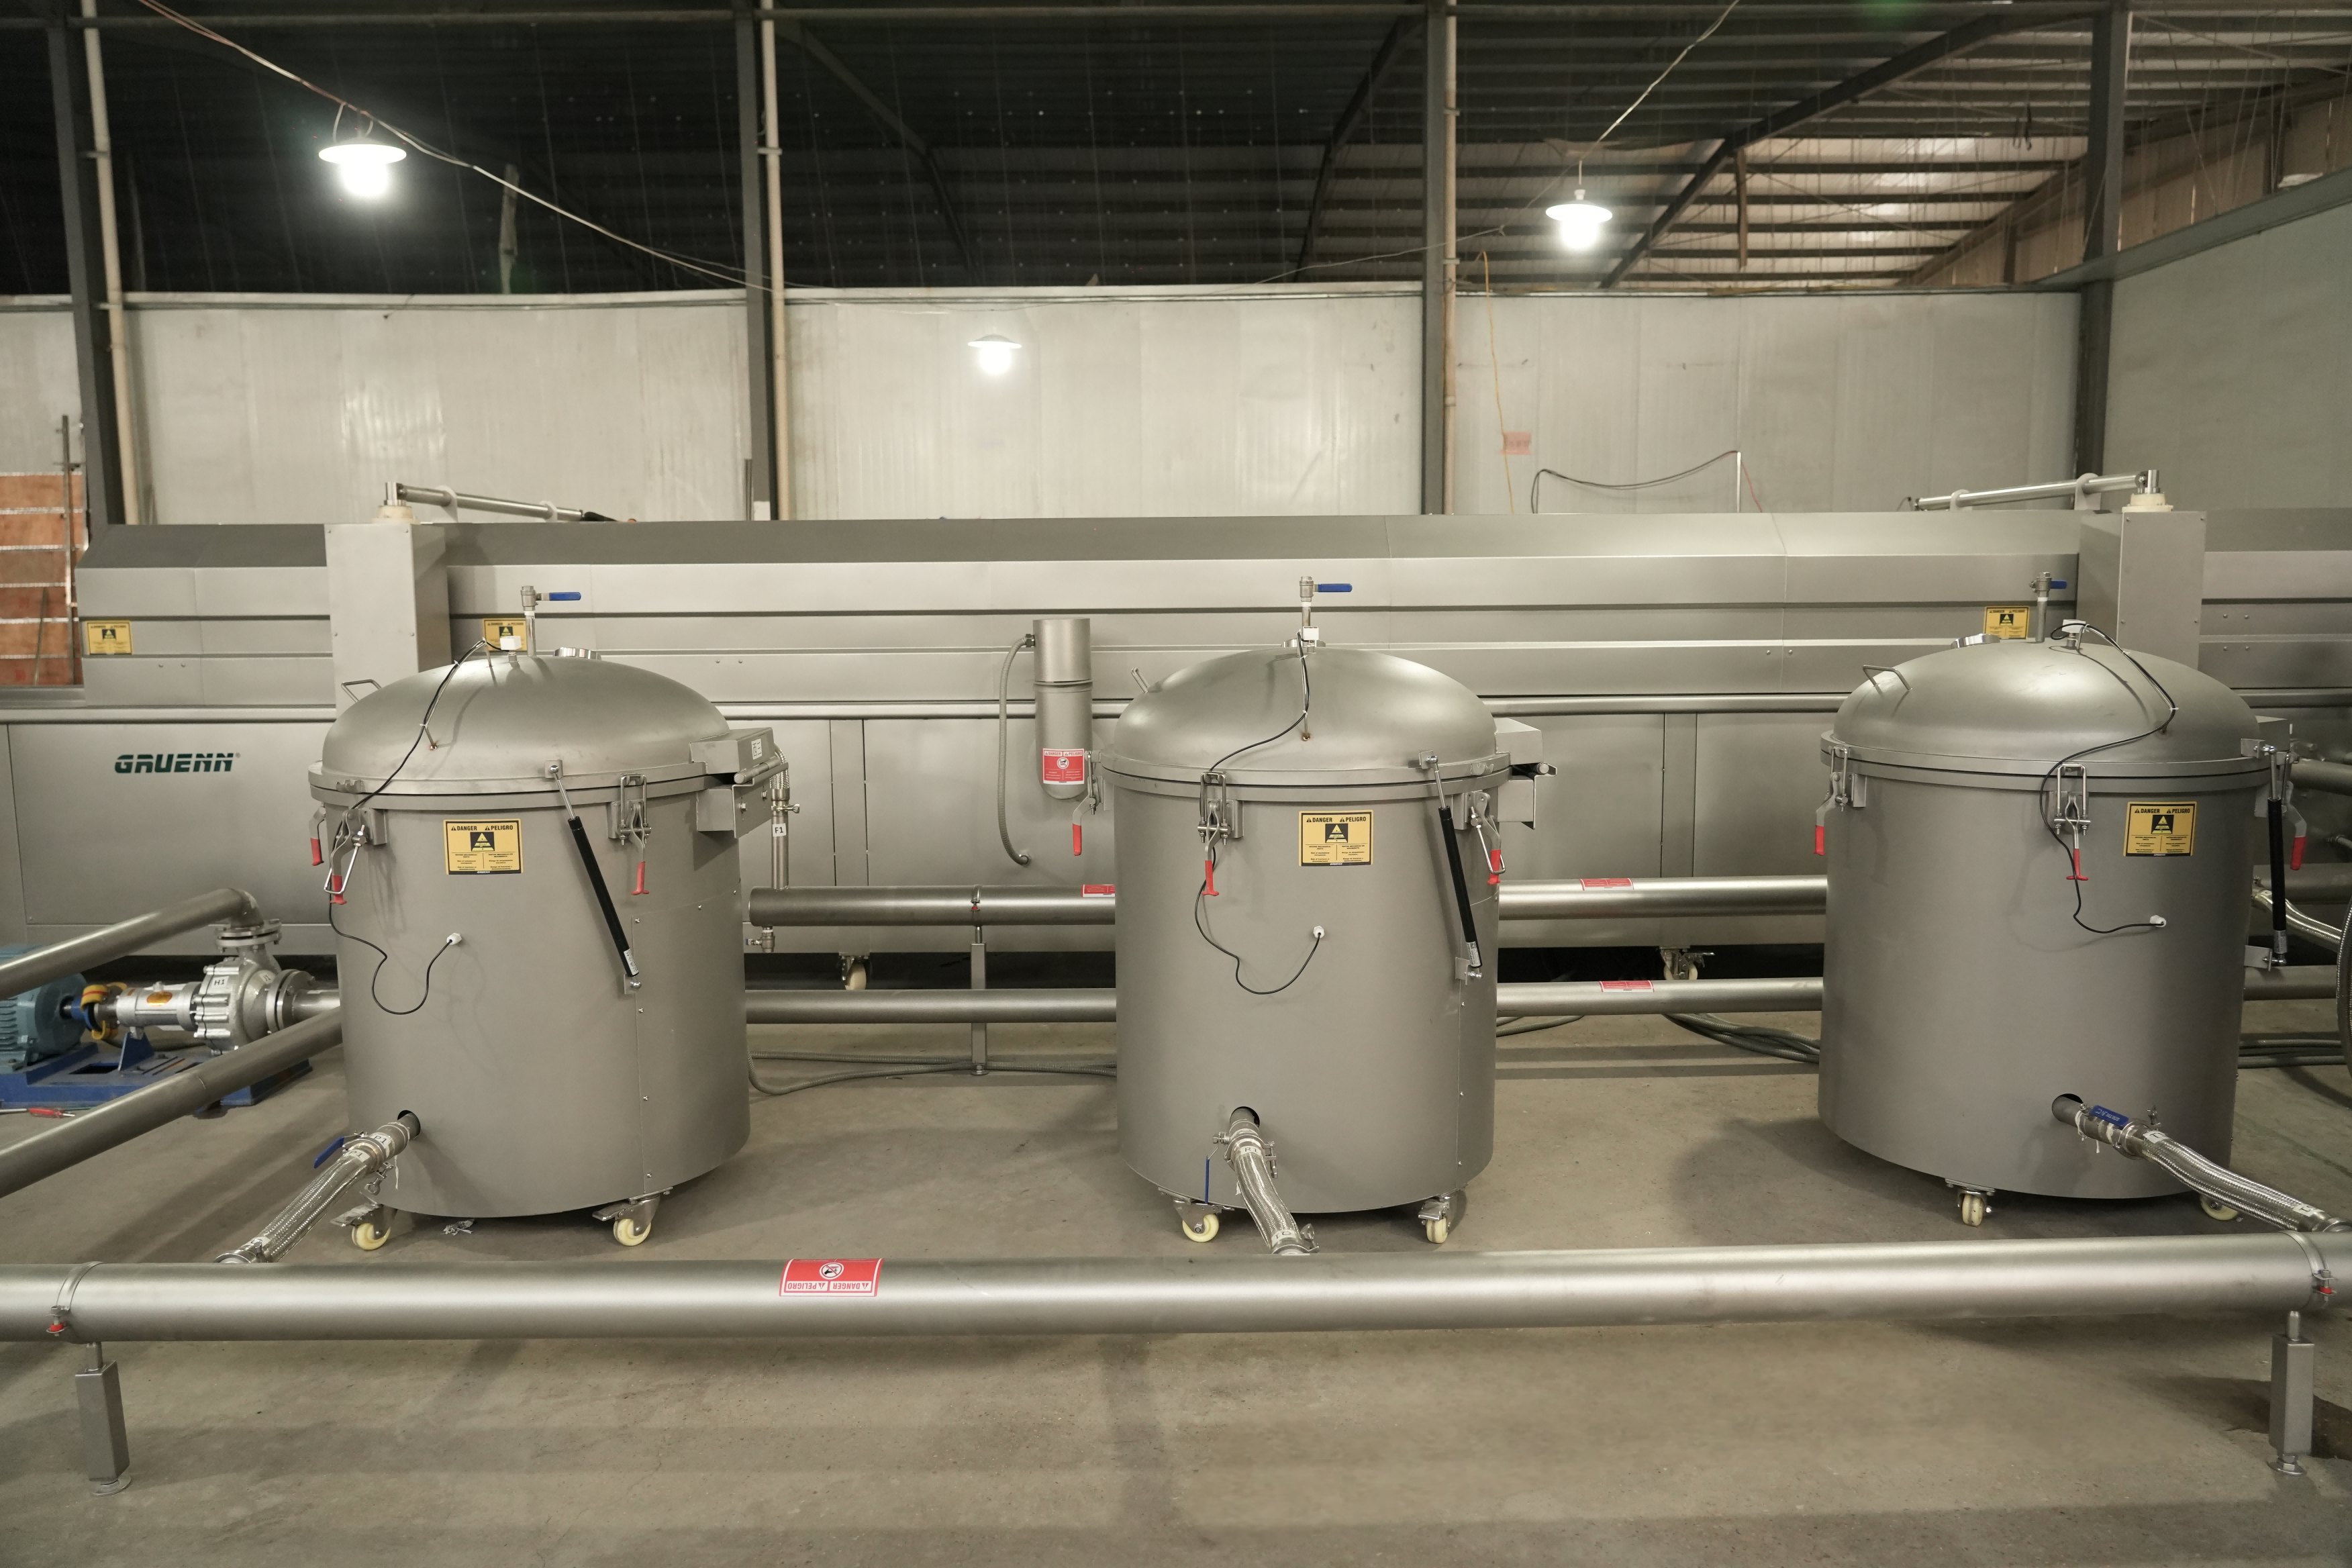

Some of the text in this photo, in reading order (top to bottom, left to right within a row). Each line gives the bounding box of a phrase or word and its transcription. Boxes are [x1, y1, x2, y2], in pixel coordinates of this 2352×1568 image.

[115, 753, 234, 773] GRUENN
[374, 1135, 387, 1144] P1
[348, 1150, 363, 1159] P1
